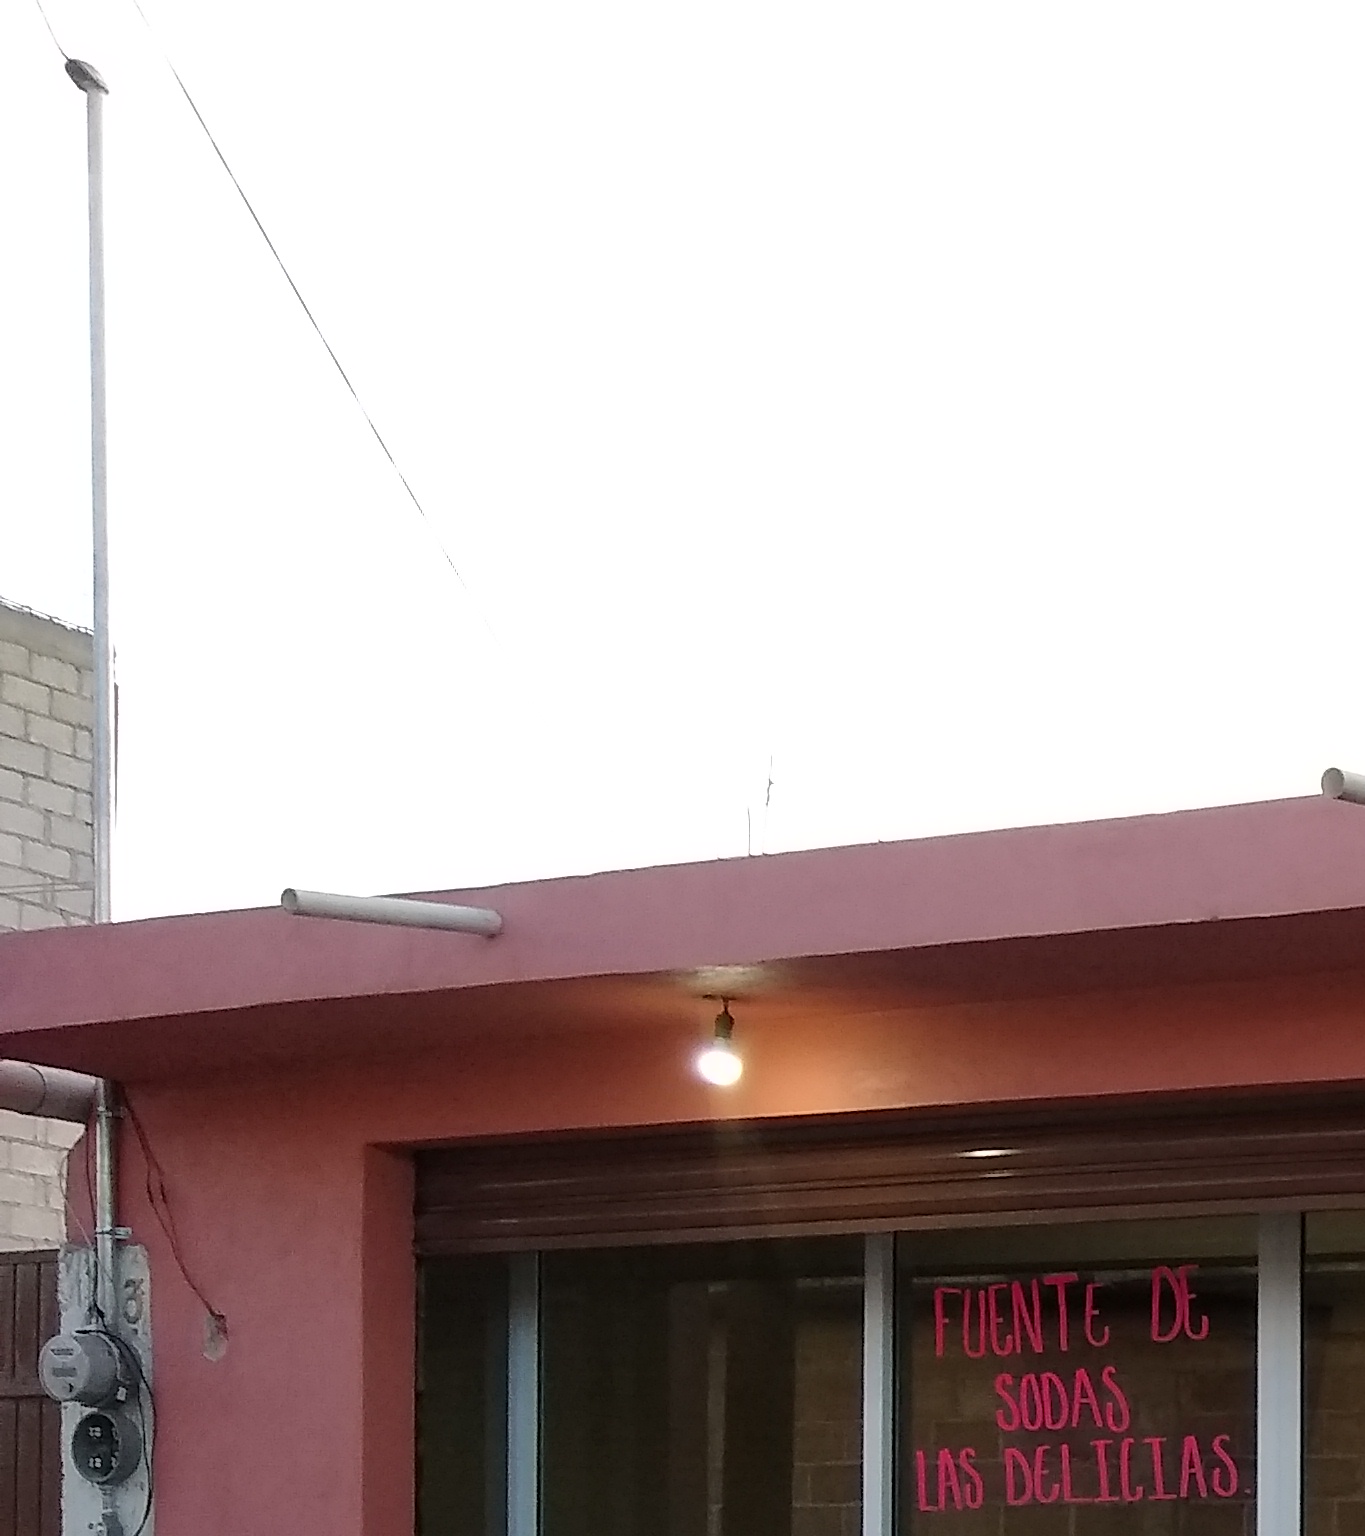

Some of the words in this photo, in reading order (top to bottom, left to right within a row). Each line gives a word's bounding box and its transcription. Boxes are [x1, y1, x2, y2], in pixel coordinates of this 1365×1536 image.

[933, 1272, 1109, 1357] FUENTE
[1150, 1265, 1209, 1342] DE
[995, 1365, 1131, 1434] SODAS
[915, 1447, 984, 1512] LAS
